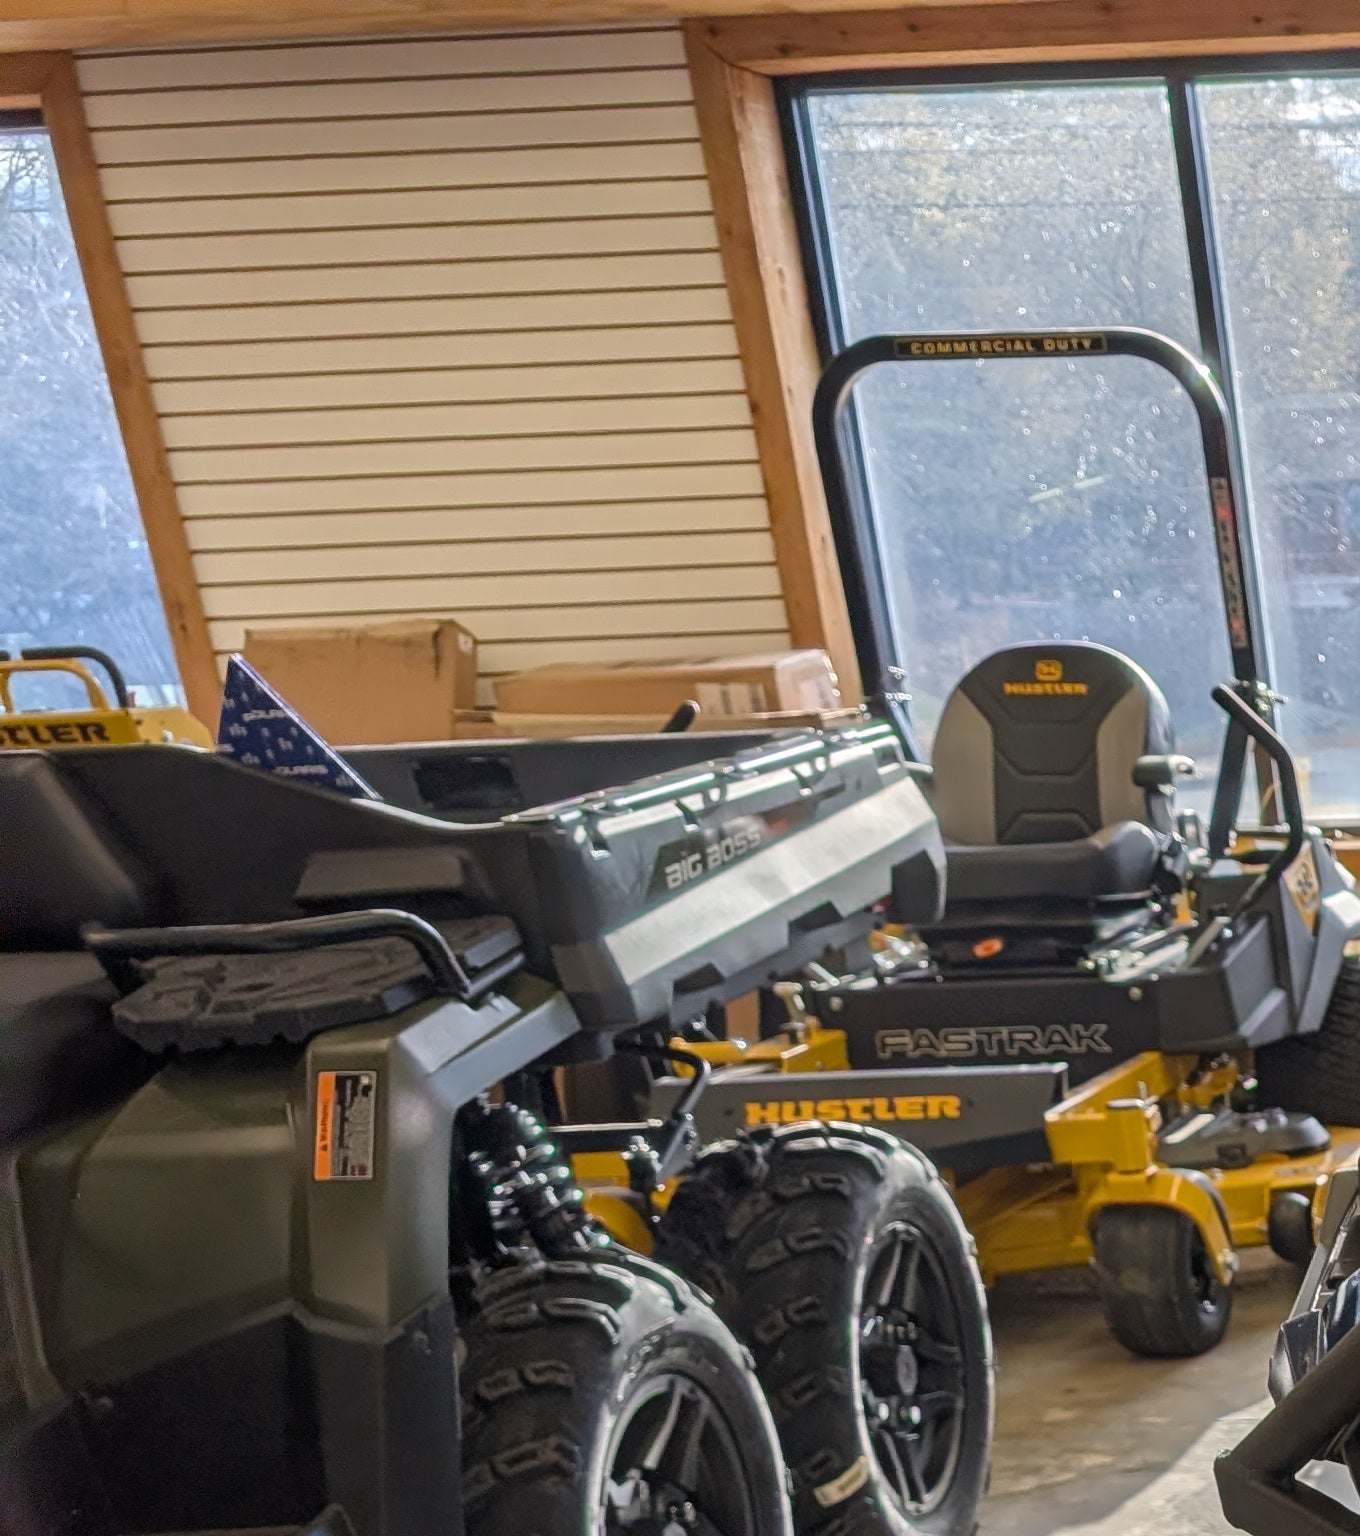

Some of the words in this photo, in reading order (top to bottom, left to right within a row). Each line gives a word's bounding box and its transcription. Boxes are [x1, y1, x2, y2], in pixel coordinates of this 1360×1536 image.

[911, 338, 1035, 356] COMMERCIAL
[1043, 336, 1093, 352] DUTY
[664, 852, 704, 890] BIG
[706, 826, 762, 870] BOSS
[875, 1023, 1113, 1060] FASTRAK
[745, 1095, 961, 1127] HUSTLER
